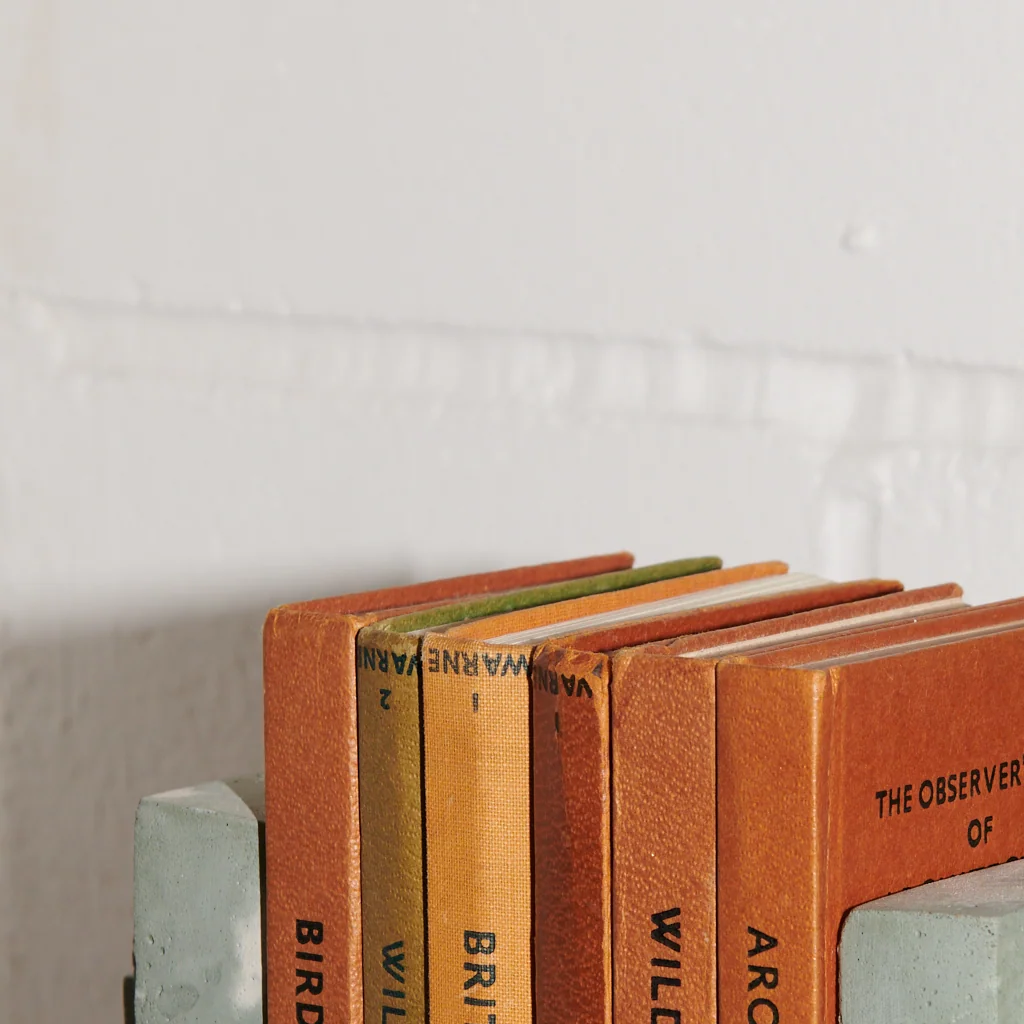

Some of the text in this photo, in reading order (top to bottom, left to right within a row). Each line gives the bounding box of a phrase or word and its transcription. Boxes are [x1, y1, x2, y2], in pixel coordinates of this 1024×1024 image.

[357, 645, 419, 676] ARN
[428, 648, 530, 677] WARNE
[379, 688, 391, 710] 2
[875, 784, 913, 819] THE
[967, 815, 993, 848] OF
